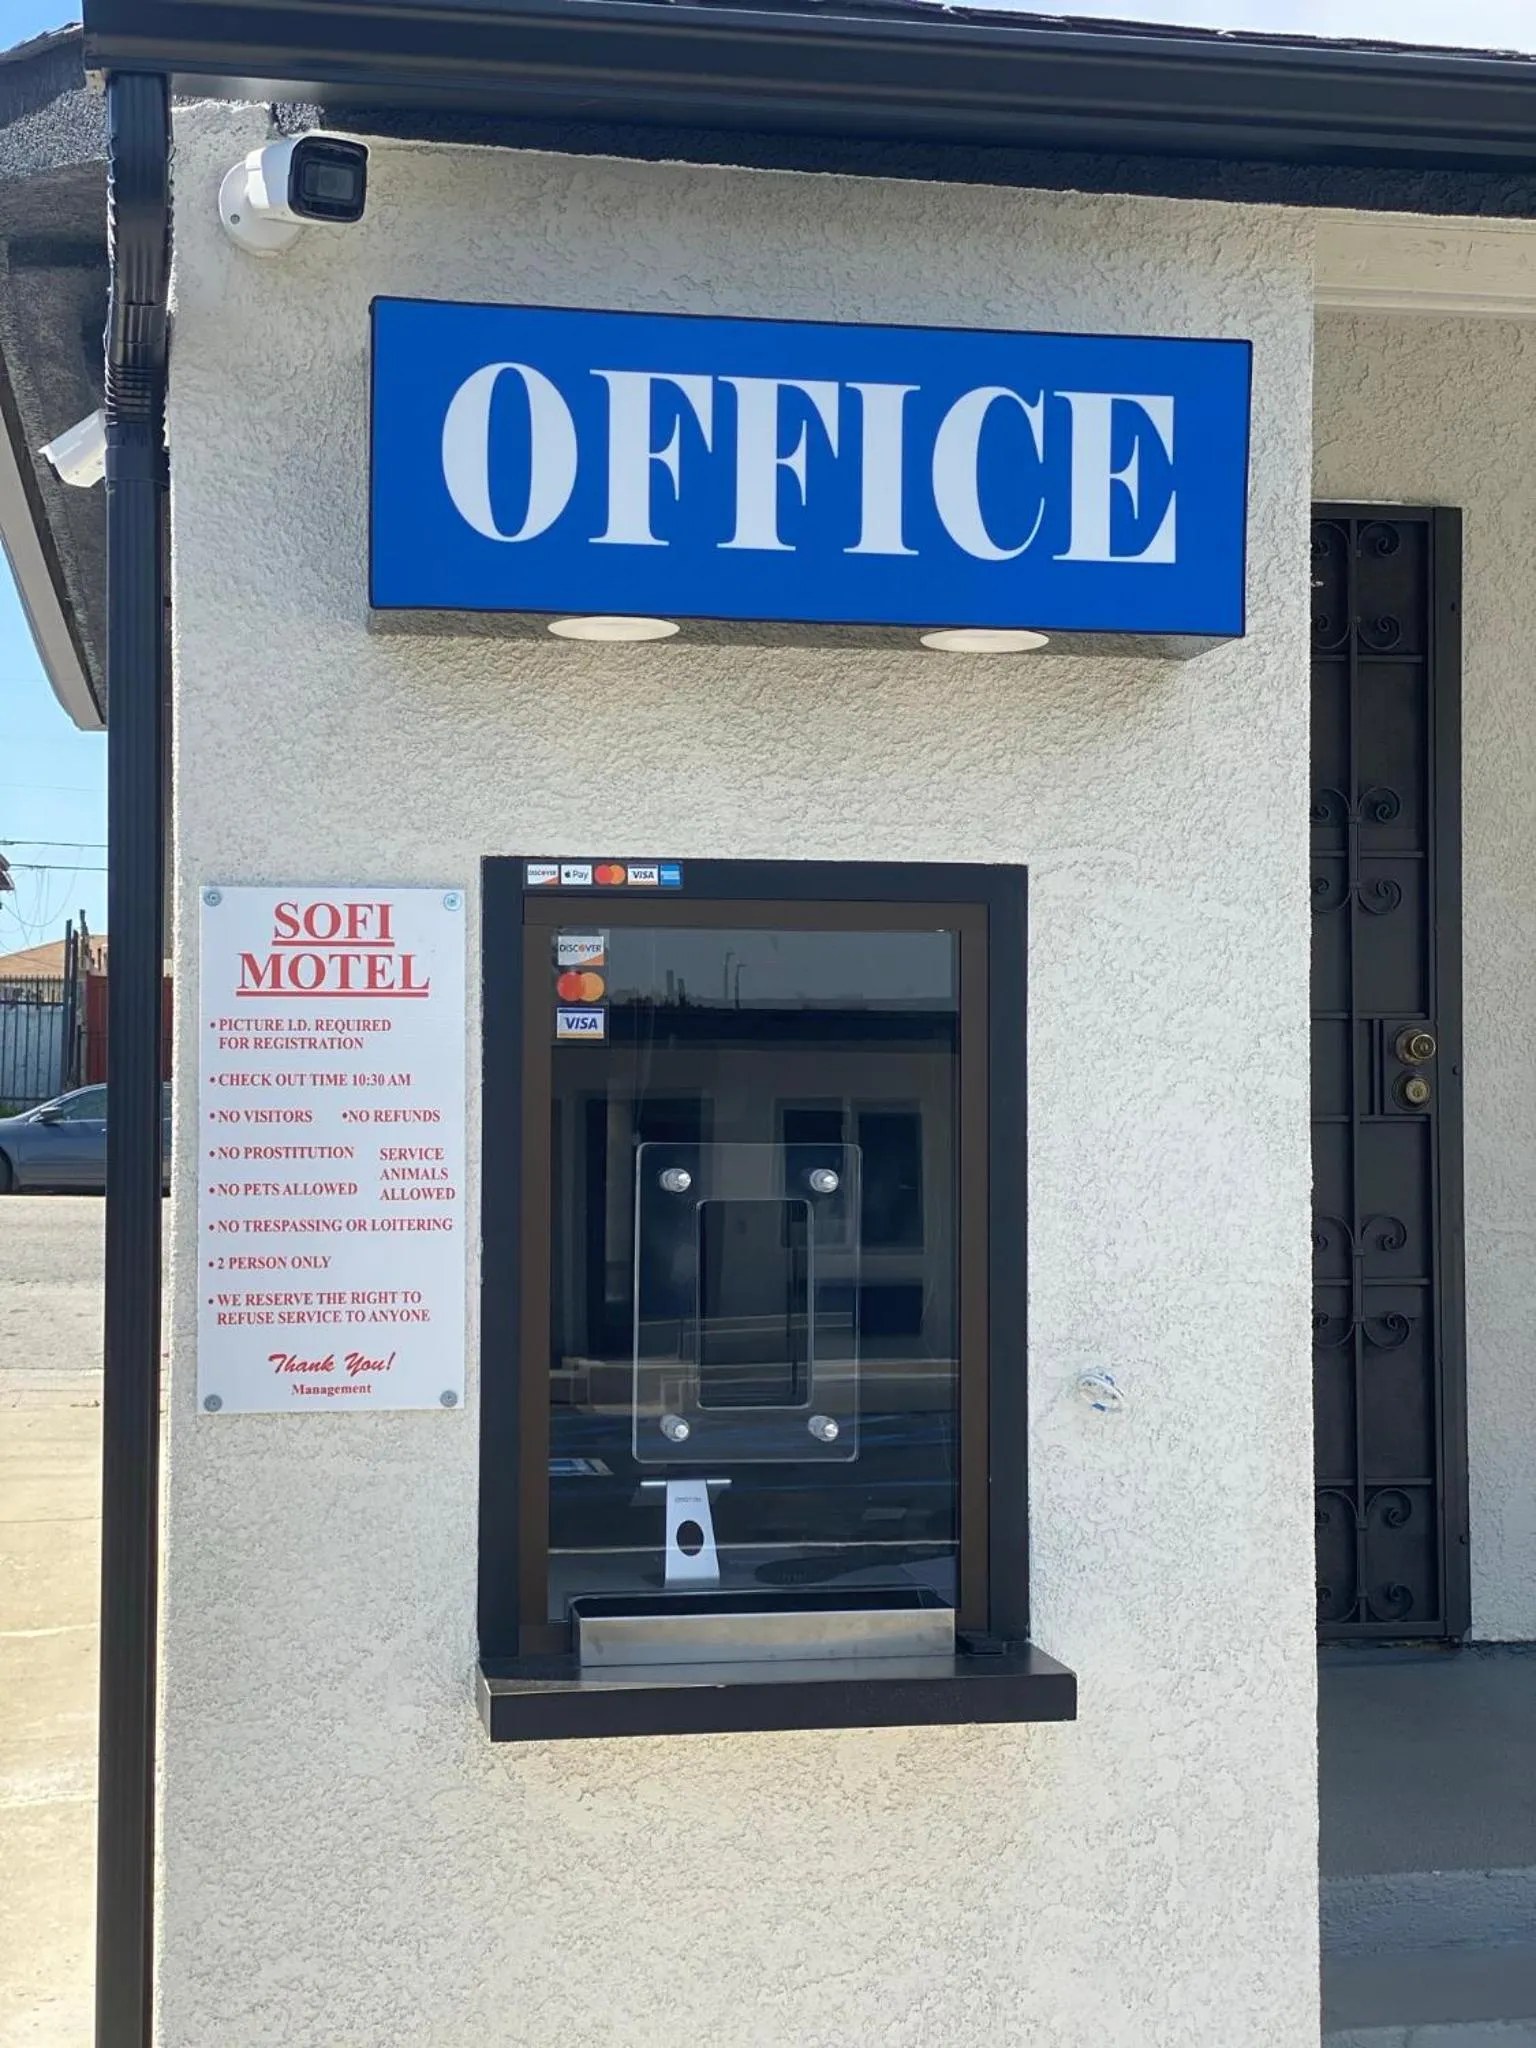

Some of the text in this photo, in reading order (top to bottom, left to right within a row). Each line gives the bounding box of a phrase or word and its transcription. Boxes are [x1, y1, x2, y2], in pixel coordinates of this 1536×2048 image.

[441, 361, 1177, 565] OFFICE
[572, 870, 589, 881] Pay
[632, 871, 655, 879] VISA
[274, 902, 394, 940] SOFI
[559, 944, 602, 953] DISCOVER
[237, 953, 431, 990] MOTEL
[219, 1019, 392, 1033] PICTURE I.D. REQUIRED
[565, 1017, 598, 1030] VISA
[219, 1037, 364, 1050] FOR REGISTRATION
[218, 1074, 411, 1086] CHECK OUT TIME 10:30 AM
[218, 1110, 313, 1123] NO VISITORS
[348, 1110, 441, 1123] NO REFUNDS
[218, 1146, 354, 1160] NO PROSTITUTION
[379, 1148, 444, 1161] SERVICE
[379, 1168, 449, 1181] ANIMALS
[218, 1182, 358, 1196] NO PETS ALLOWED
[379, 1187, 456, 1201] ALLOWED
[218, 1218, 453, 1233] NO TRESPASSING OR LOITERING
[217, 1256, 332, 1269] 2 PERSON ONLY
[217, 1291, 422, 1306] WE RESERVE THE RIGHT TO
[217, 1309, 430, 1325] REFUSE SERVICE TO ANYONE
[268, 1352, 396, 1378] Thank You!
[291, 1384, 372, 1397] Management
